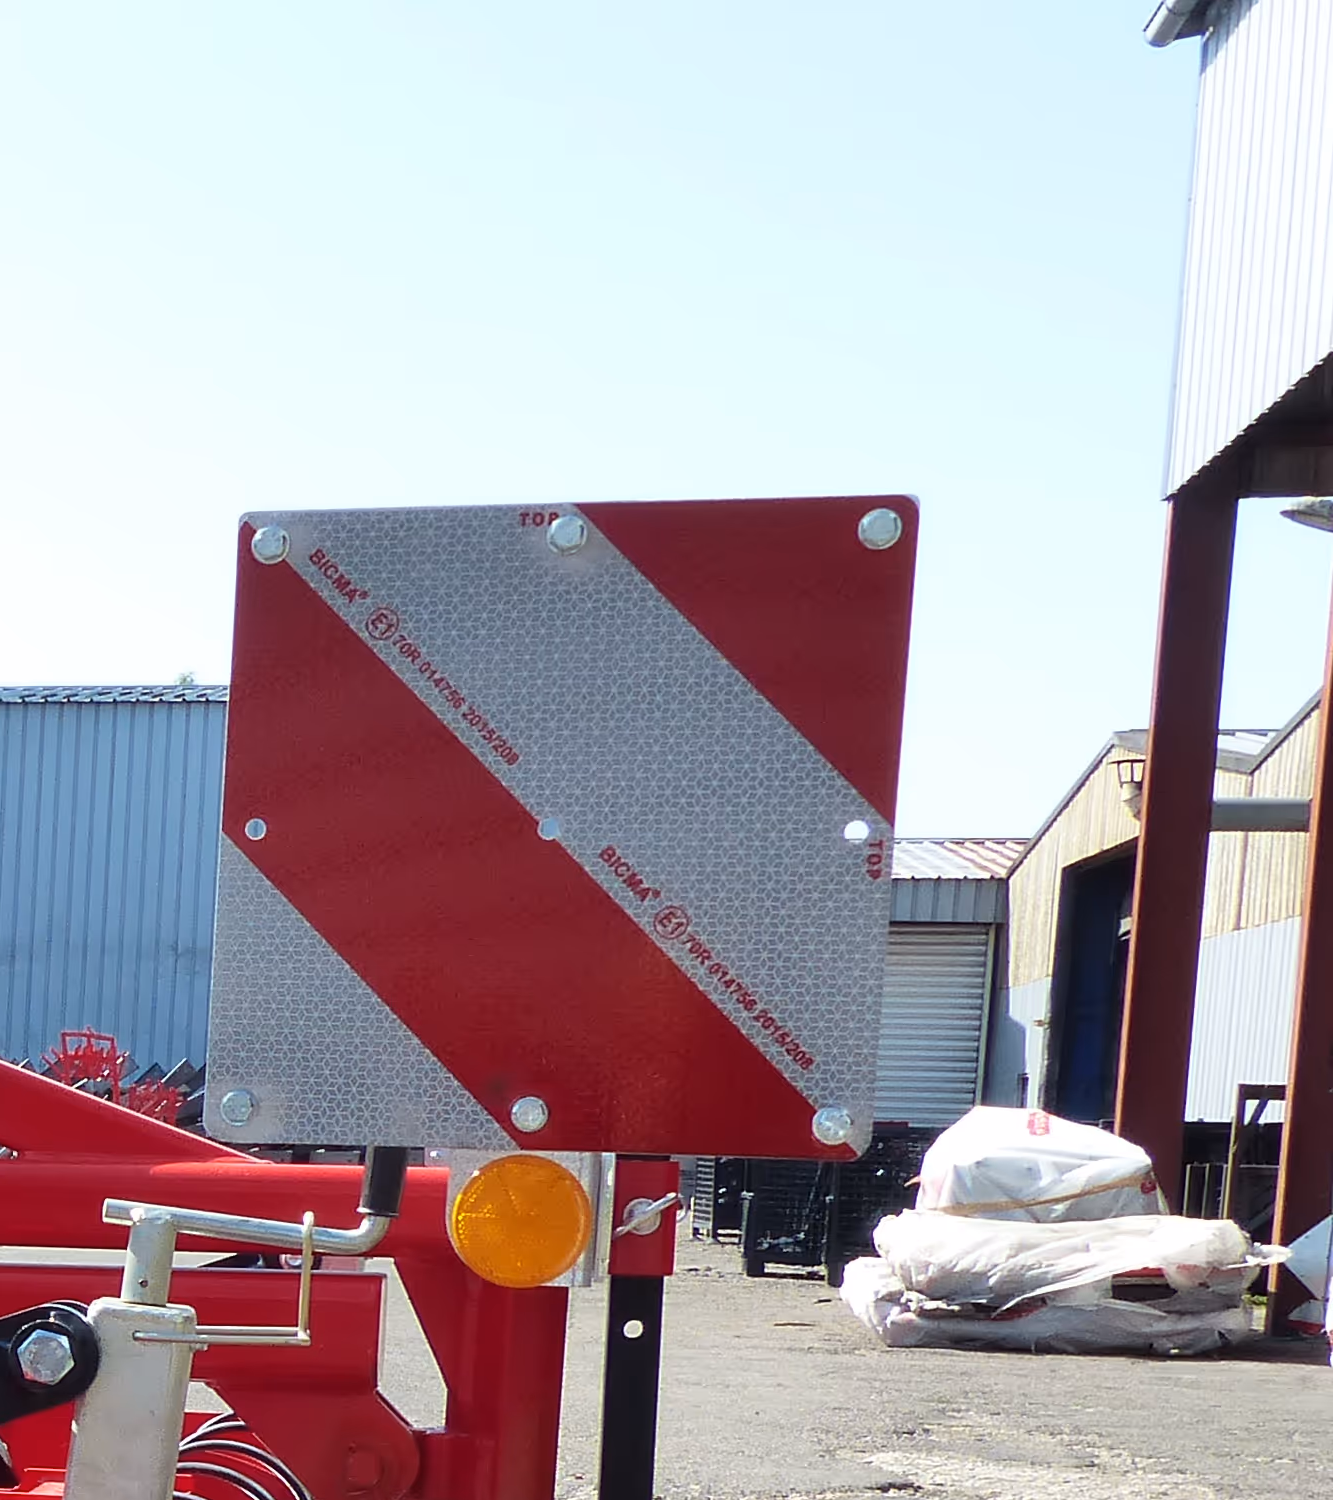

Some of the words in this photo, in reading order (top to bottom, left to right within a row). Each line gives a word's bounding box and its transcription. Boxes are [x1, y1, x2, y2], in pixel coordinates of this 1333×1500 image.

[519, 512, 559, 527] TOP
[370, 611, 397, 637] E1
[392, 634, 422, 666] 70R
[419, 661, 467, 710] 014756
[866, 840, 884, 879] TOP
[659, 909, 686, 936] E1
[682, 935, 713, 966] 70R
[709, 962, 759, 1012] 014756
